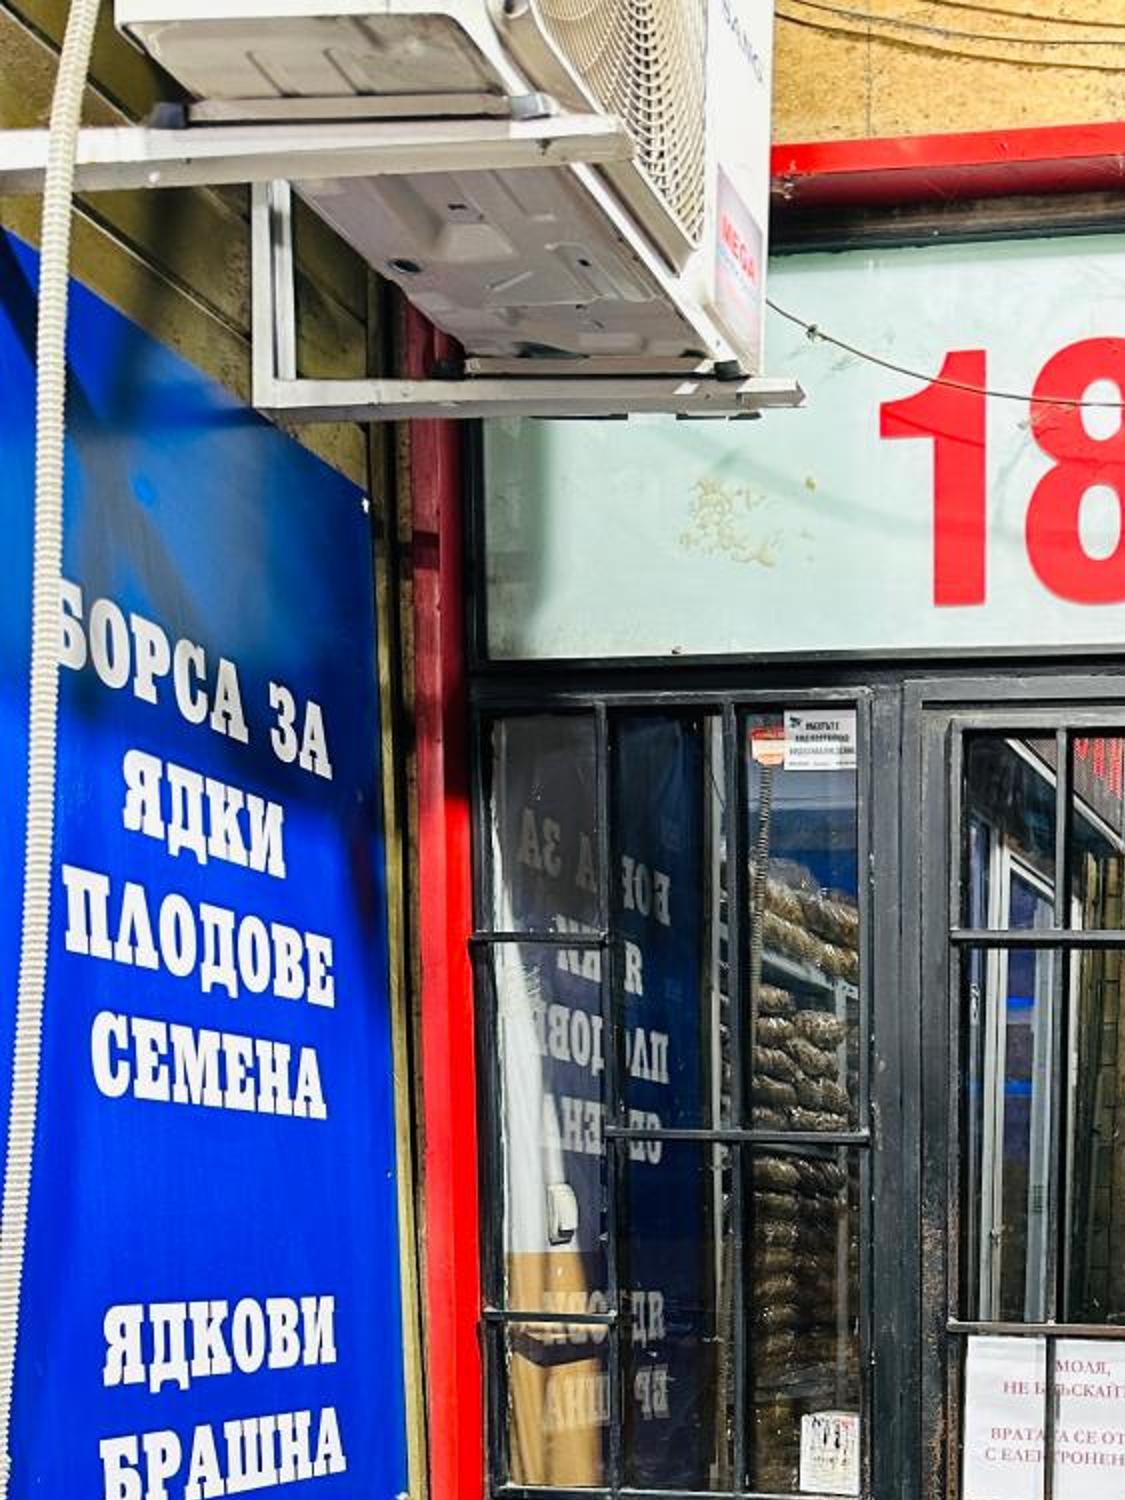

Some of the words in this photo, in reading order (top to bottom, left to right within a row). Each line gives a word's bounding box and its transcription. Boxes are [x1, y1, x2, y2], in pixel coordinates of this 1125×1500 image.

[56, 576, 249, 745] БОРСА
[269, 681, 333, 781] ЗА
[122, 749, 286, 879] ЯДКИ
[61, 864, 335, 1009] ПЛОДОВЕ
[91, 1011, 327, 1120] СЕМЕНА
[102, 1295, 337, 1394] ЯДКОВИ
[1003, 1381, 1029, 1396] НЕ
[984, 1448, 997, 1462] С
[1000, 1449, 1125, 1467] ЕЛЕРОНЕН
[990, 1427, 1069, 1443] ВРАТАА
[1073, 1430, 1095, 1445] СЕ
